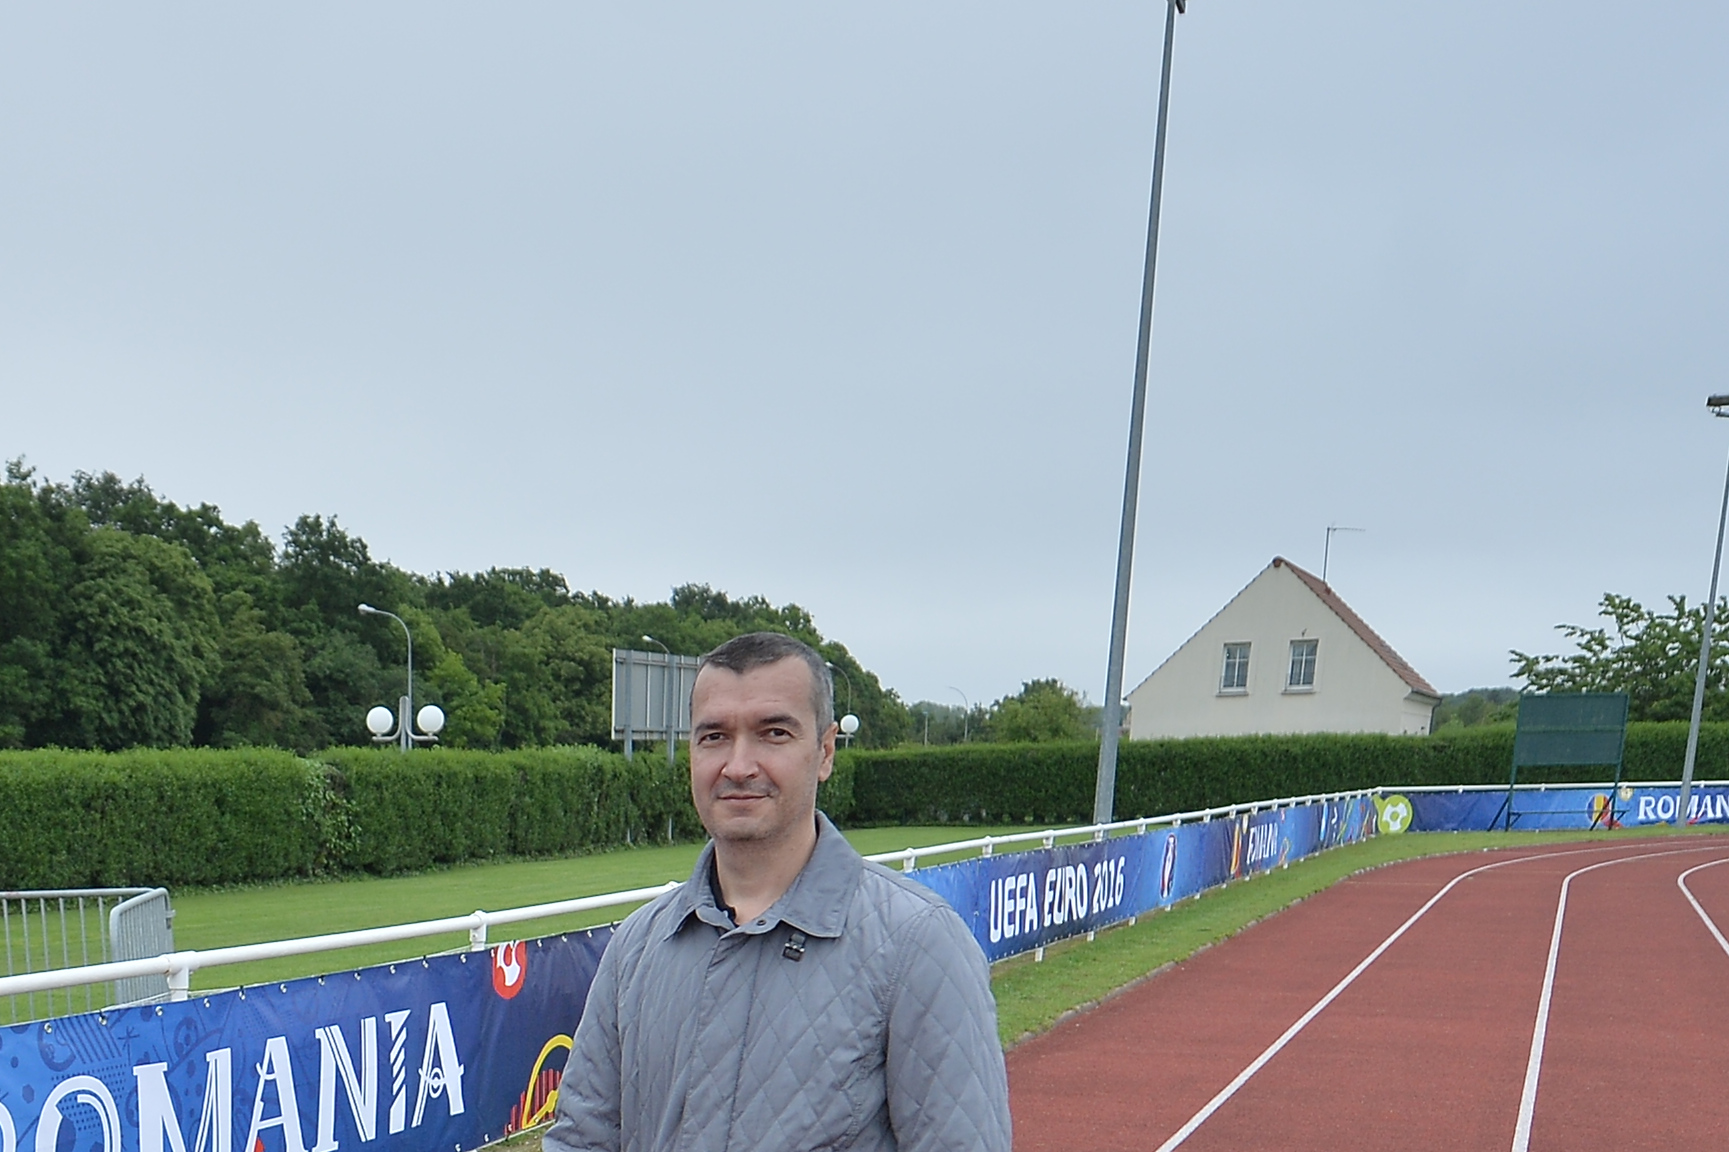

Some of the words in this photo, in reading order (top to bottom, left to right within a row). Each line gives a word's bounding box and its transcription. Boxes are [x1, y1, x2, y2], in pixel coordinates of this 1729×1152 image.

[989, 872, 1039, 943] UEFA
[1043, 863, 1088, 927] EURO
[1092, 856, 1126, 914] 2016
